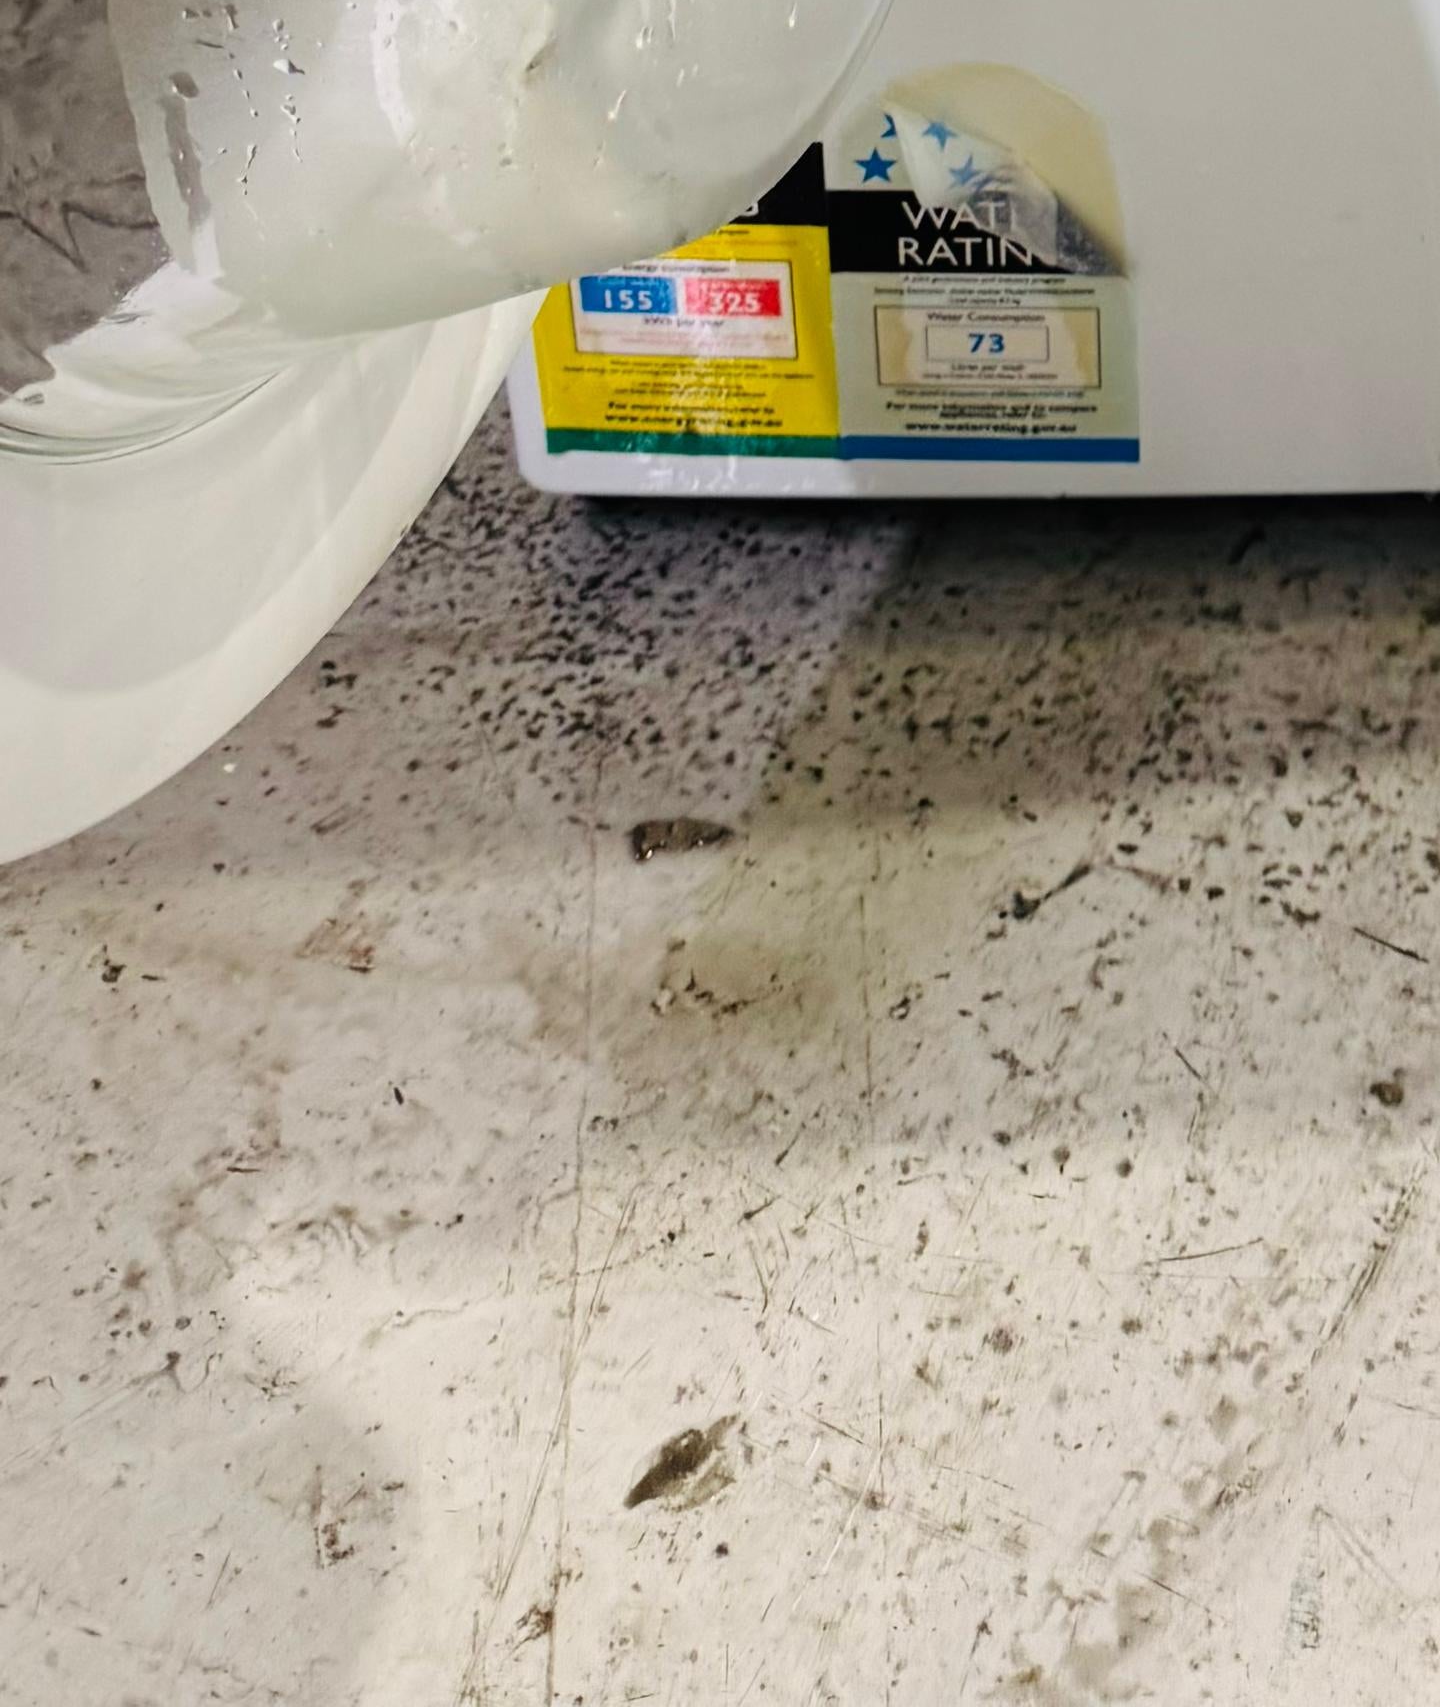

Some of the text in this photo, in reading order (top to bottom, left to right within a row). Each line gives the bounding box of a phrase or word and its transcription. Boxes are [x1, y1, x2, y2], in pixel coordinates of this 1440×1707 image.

[605, 289, 652, 310] 155
[710, 291, 761, 313] 325
[968, 332, 1005, 354] 73
